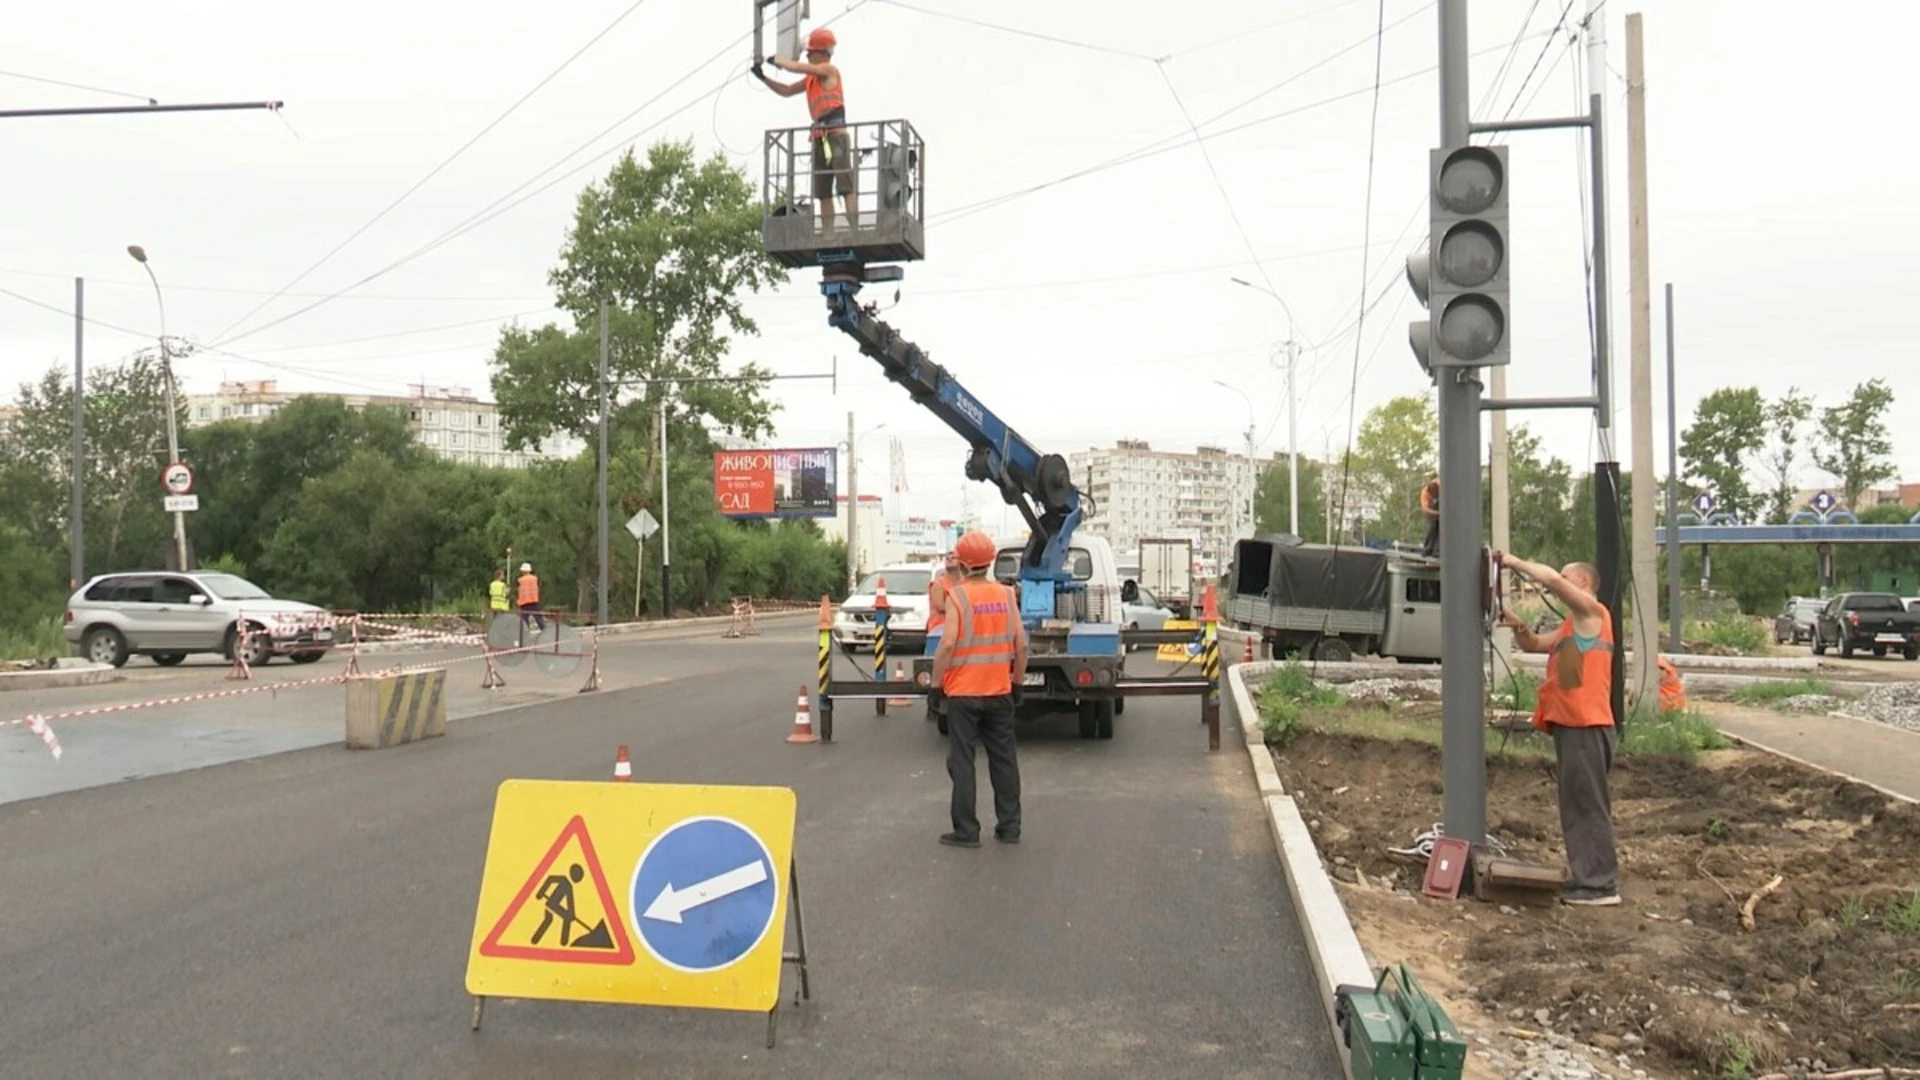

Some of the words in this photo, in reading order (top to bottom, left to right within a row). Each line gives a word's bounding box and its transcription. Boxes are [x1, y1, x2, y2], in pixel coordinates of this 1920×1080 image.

[720, 450, 831, 471] ЖИВОПИСНЫЙ
[719, 492, 751, 510] САД
[1700, 495, 1709, 510] А
